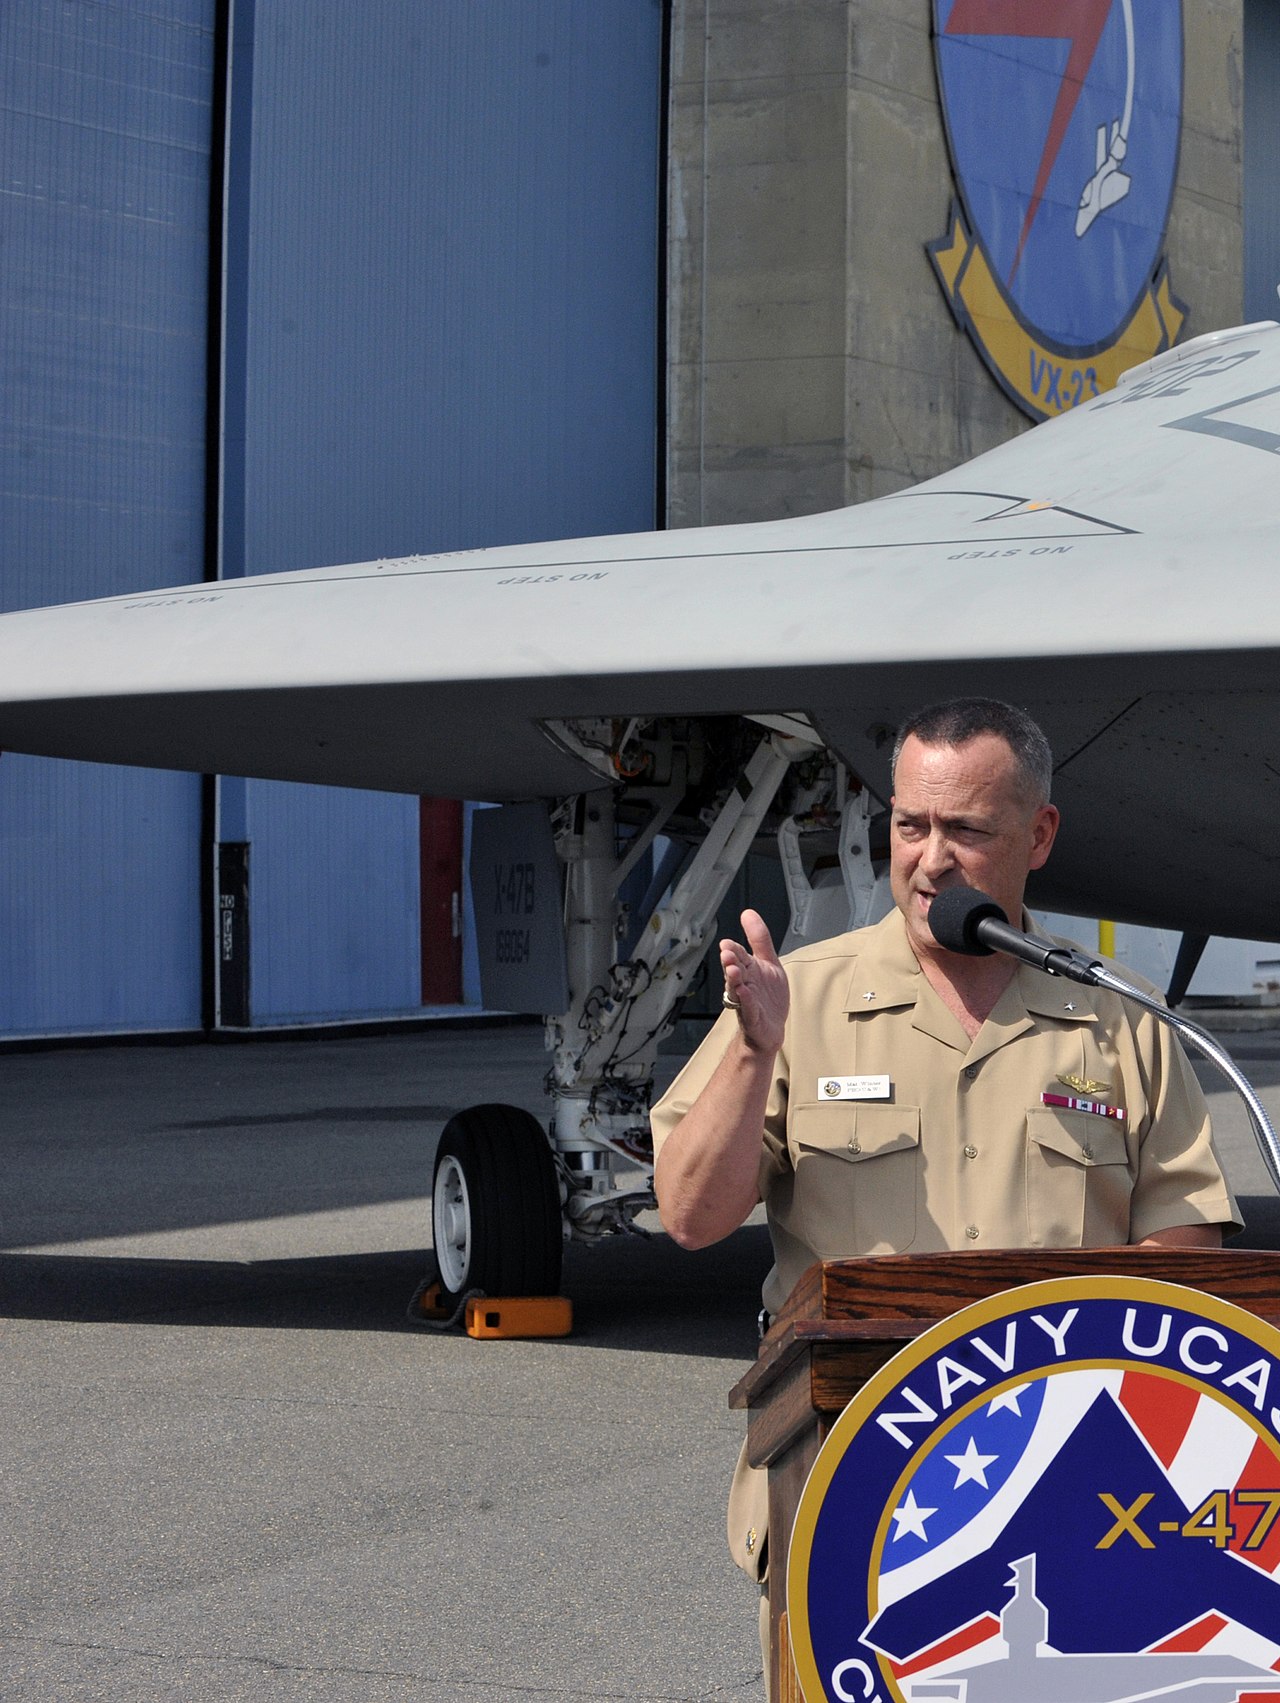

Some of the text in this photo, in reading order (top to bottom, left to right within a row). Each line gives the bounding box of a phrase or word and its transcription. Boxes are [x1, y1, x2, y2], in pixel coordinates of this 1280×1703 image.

[946, 545, 1074, 561] NO STEP
[496, 571, 609, 585] NO STEP
[224, 912, 232, 958] PUSH
[875, 1306, 1080, 1450] NAVY
